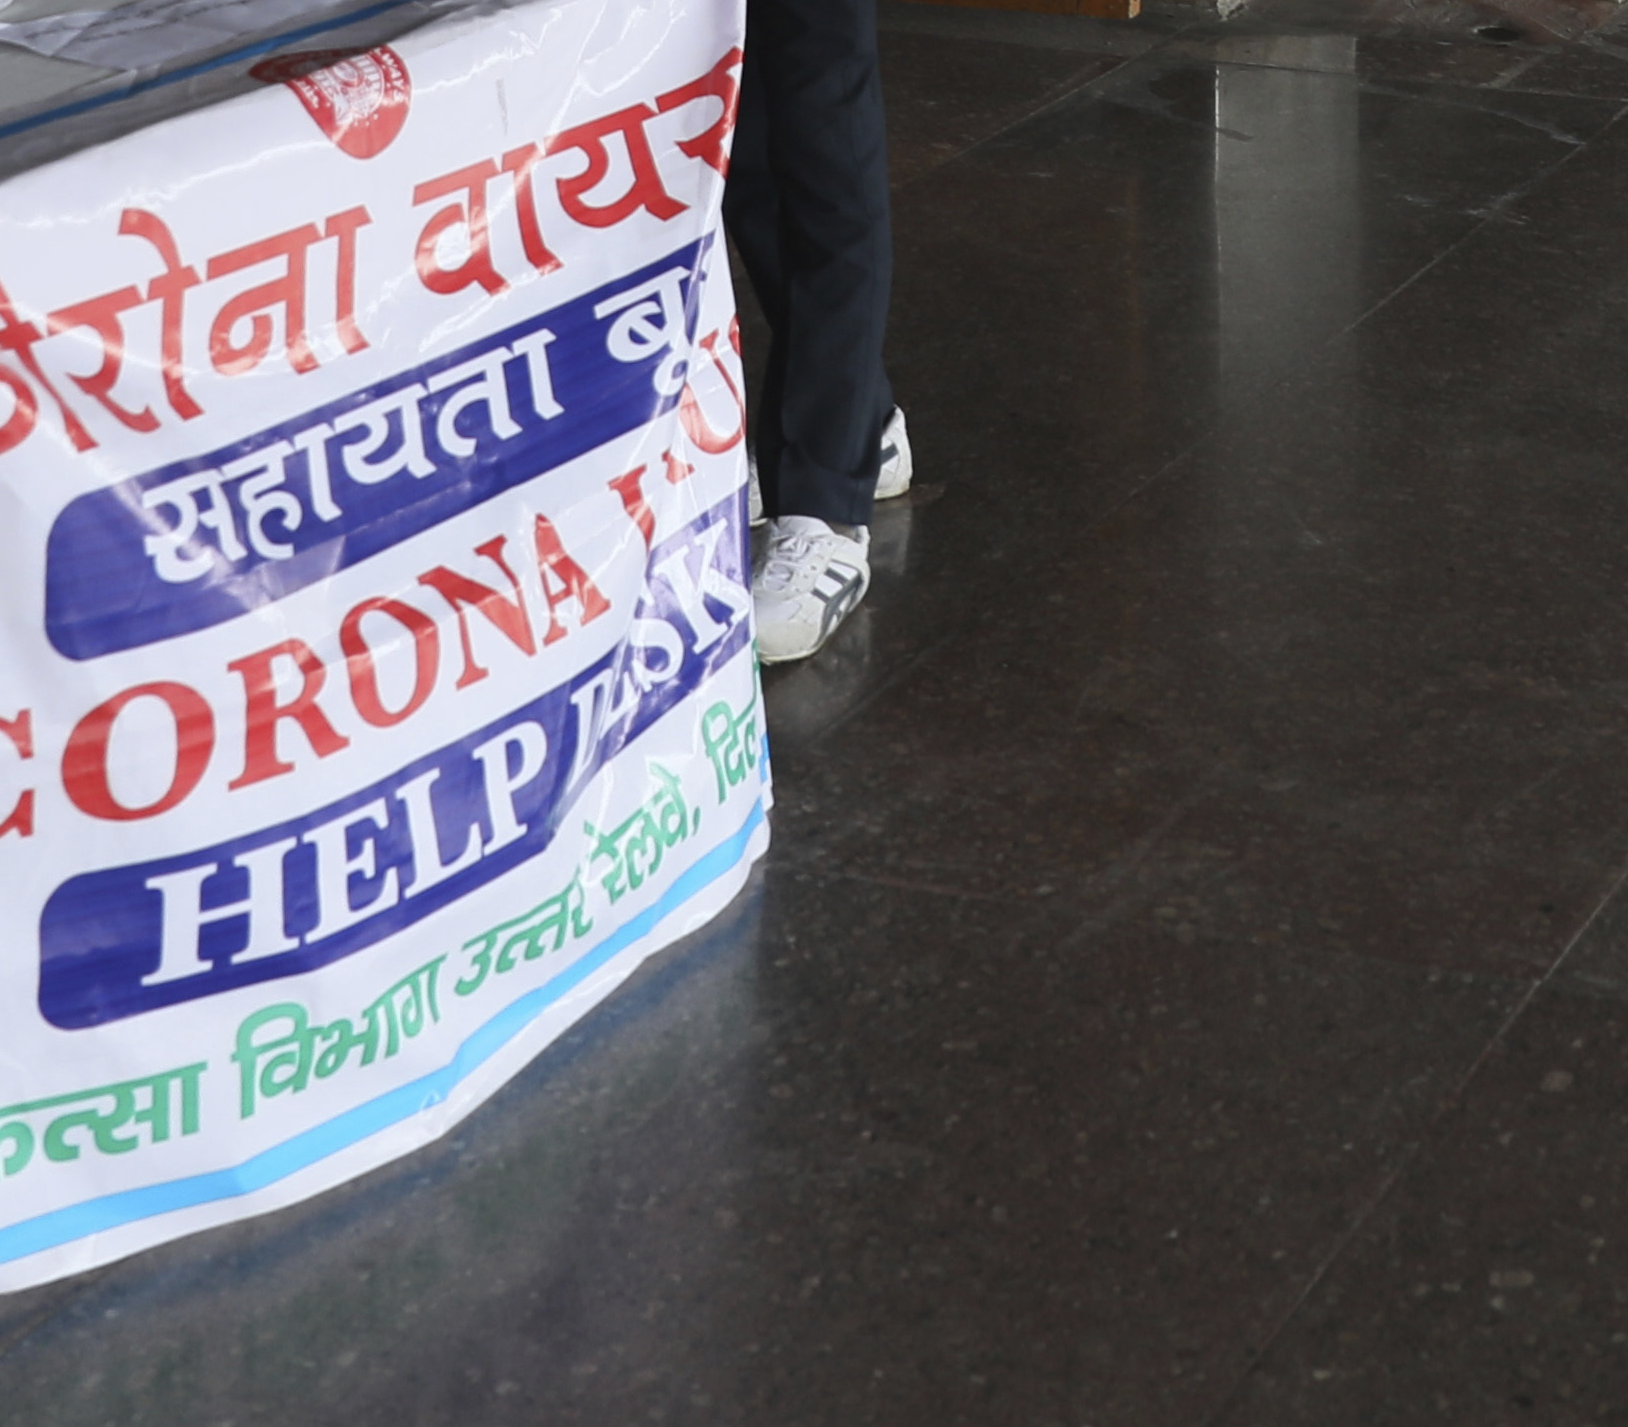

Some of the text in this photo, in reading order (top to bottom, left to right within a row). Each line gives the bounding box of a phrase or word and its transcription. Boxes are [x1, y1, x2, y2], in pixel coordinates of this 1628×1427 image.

[414, 48, 745, 294] वायर
[144, 328, 564, 583] सहायता
[593, 265, 698, 397] बू
[140, 719, 548, 987] HELP
[234, 949, 448, 1117] विभाग
[454, 865, 593, 996] उत्तर
